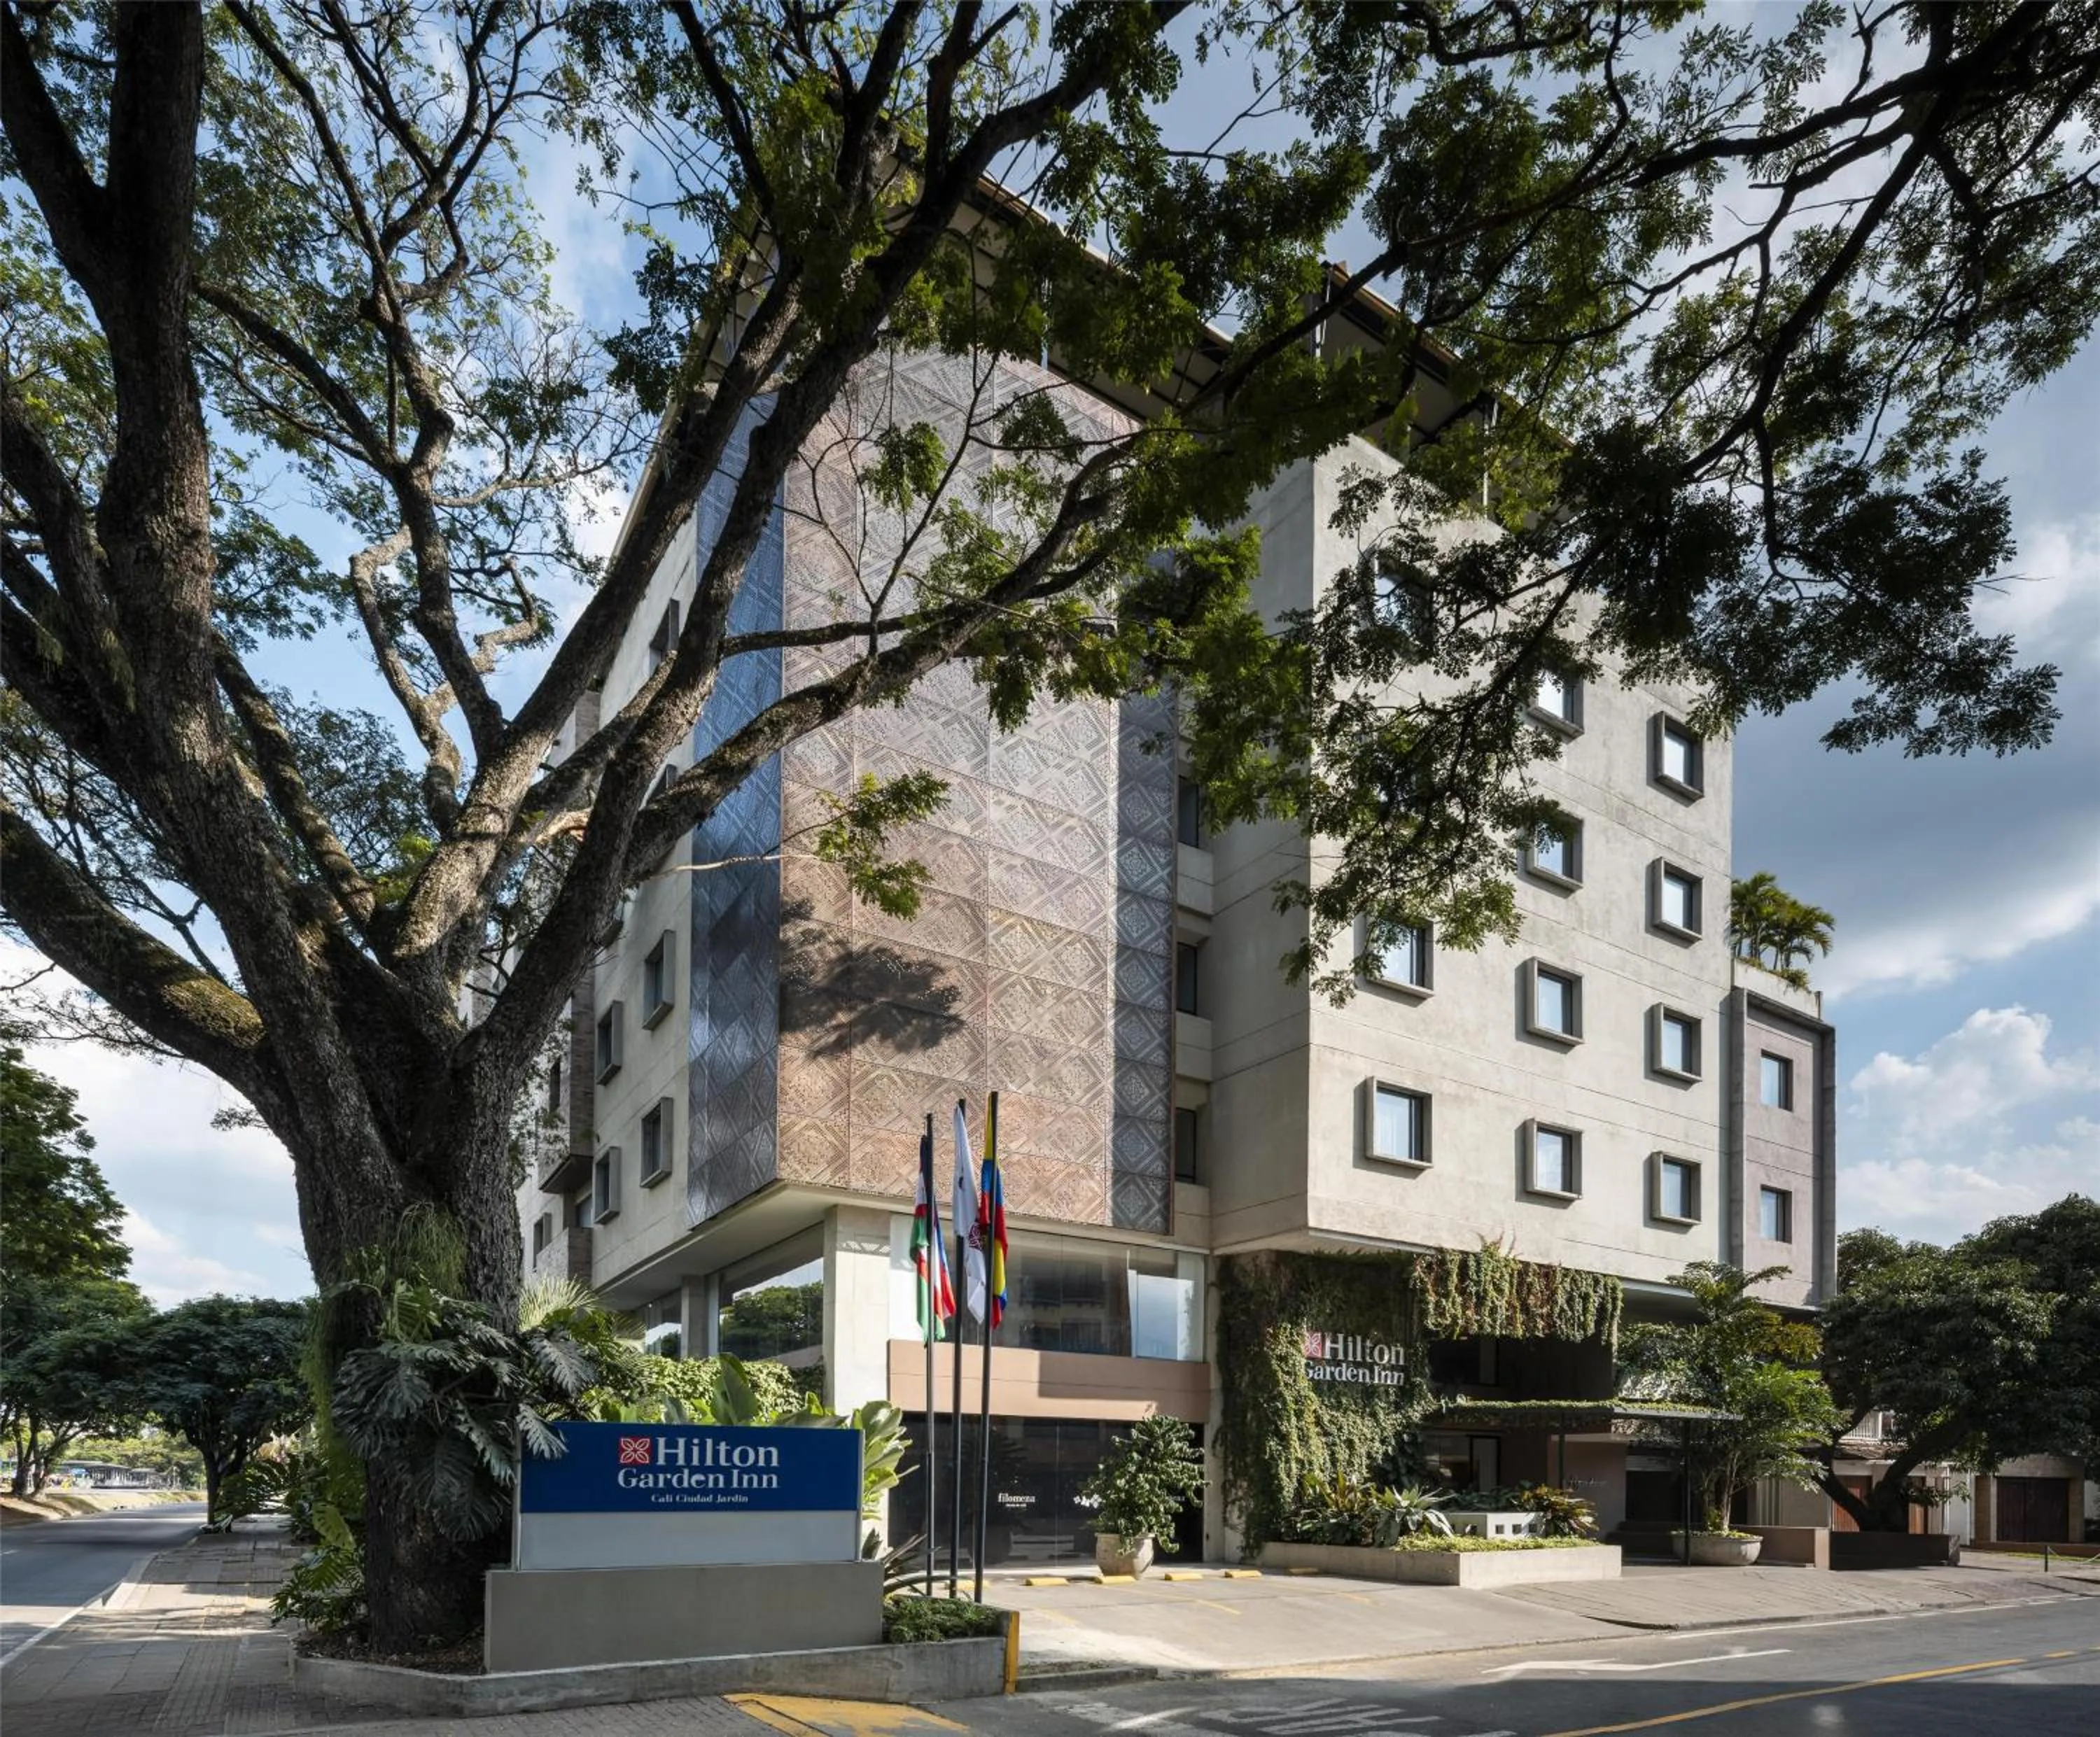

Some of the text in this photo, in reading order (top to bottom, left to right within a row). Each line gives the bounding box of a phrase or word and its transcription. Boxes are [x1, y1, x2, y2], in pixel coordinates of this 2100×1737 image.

[1324, 1332, 1404, 1365] Hilton
[1373, 1365, 1404, 1386] Inn
[656, 1437, 780, 1467] Hilton
[617, 1468, 778, 1489] Garden Inn
[651, 1493, 673, 1503] Cali
[676, 1493, 713, 1503] Ciudad
